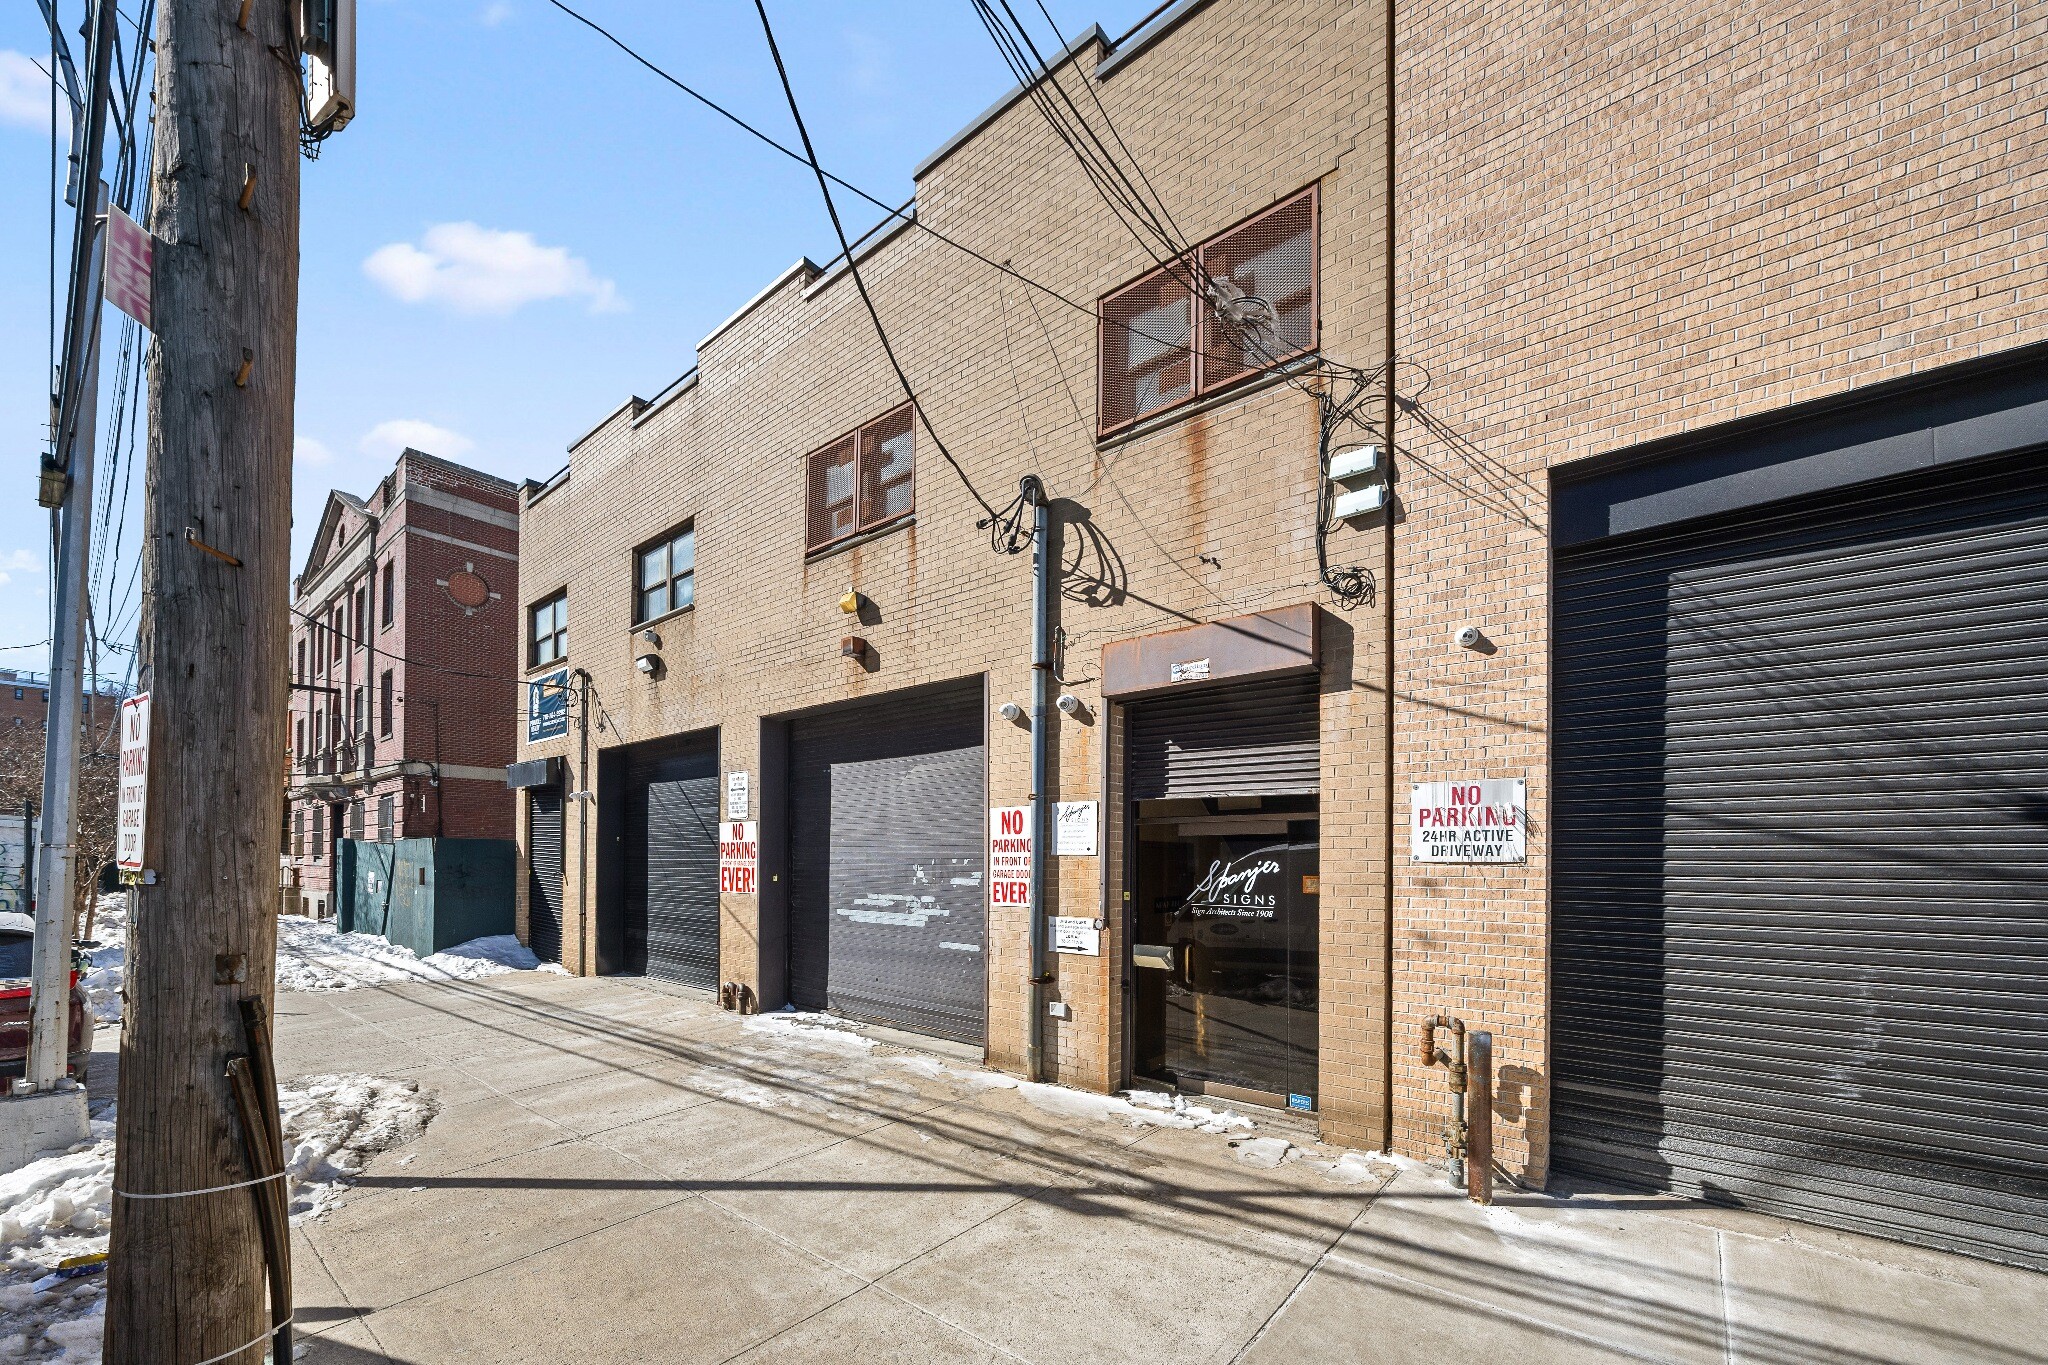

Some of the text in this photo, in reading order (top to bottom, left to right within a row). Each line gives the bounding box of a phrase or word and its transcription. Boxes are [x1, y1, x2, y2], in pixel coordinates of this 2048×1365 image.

[129, 712, 141, 742] NO
[123, 746, 145, 777] PARKING
[1451, 785, 1481, 806] NO
[123, 809, 140, 827] GARAGE
[1001, 810, 1023, 835] NO
[1419, 804, 1516, 827] PARKING
[732, 823, 744, 841] NO
[1422, 830, 1457, 843] 24HR
[1463, 829, 1514, 842] ACTIVE
[124, 833, 137, 852] DOOR
[721, 841, 756, 859] PARKING
[1431, 844, 1503, 857] DRIVEWAY
[993, 857, 1000, 866] IN
[1001, 857, 1022, 866] FRONT
[721, 867, 755, 893] EVER!
[993, 870, 1014, 879] GARAGE
[1186, 860, 1280, 903] Spanjer
[1223, 894, 1276, 906] SIGNS
[1191, 906, 1274, 918] Sign Architects Since 1908
